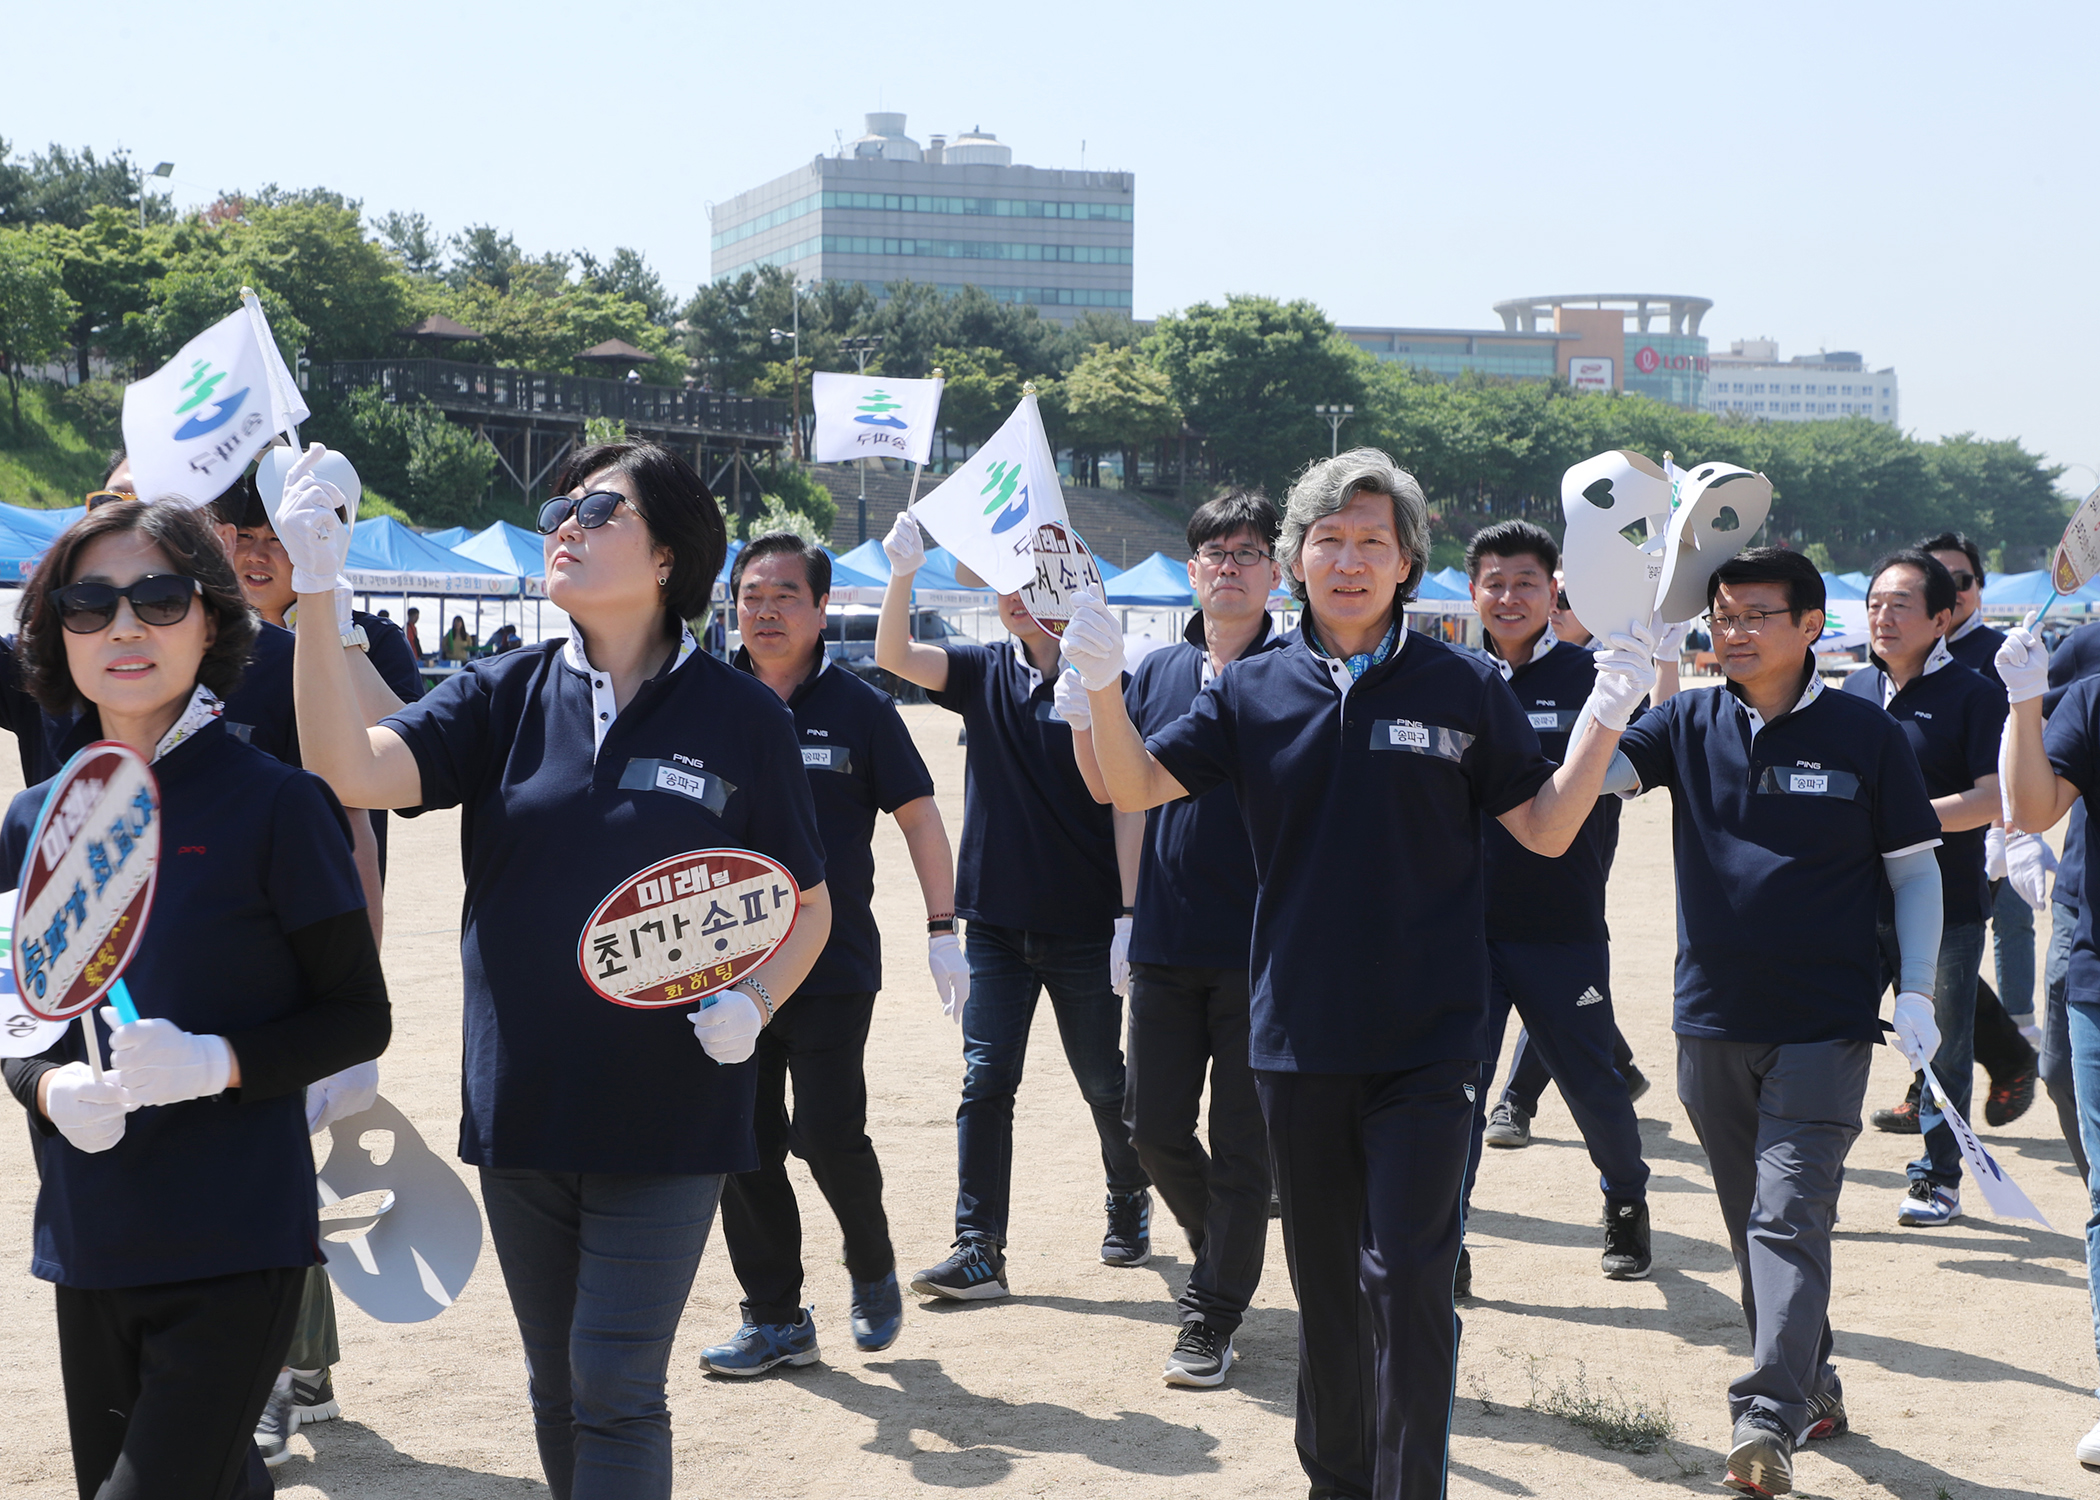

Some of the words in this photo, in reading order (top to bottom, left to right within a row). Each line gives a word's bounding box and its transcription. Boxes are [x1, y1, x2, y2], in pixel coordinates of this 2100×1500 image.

[445, 575, 482, 591] 중구의회
[1396, 718, 1423, 729] PING
[806, 728, 829, 737] PING
[1397, 729, 1426, 744] 송파구
[672, 753, 704, 769] PING
[1796, 760, 1822, 770] PING
[666, 772, 699, 793] 송파구
[1797, 778, 1824, 789] 송파구
[636, 863, 731, 908] 미래팀
[20, 879, 89, 998] 송파가
[593, 913, 691, 980] 최강
[701, 884, 790, 952] 송파
[664, 962, 734, 1001] 화이팅
